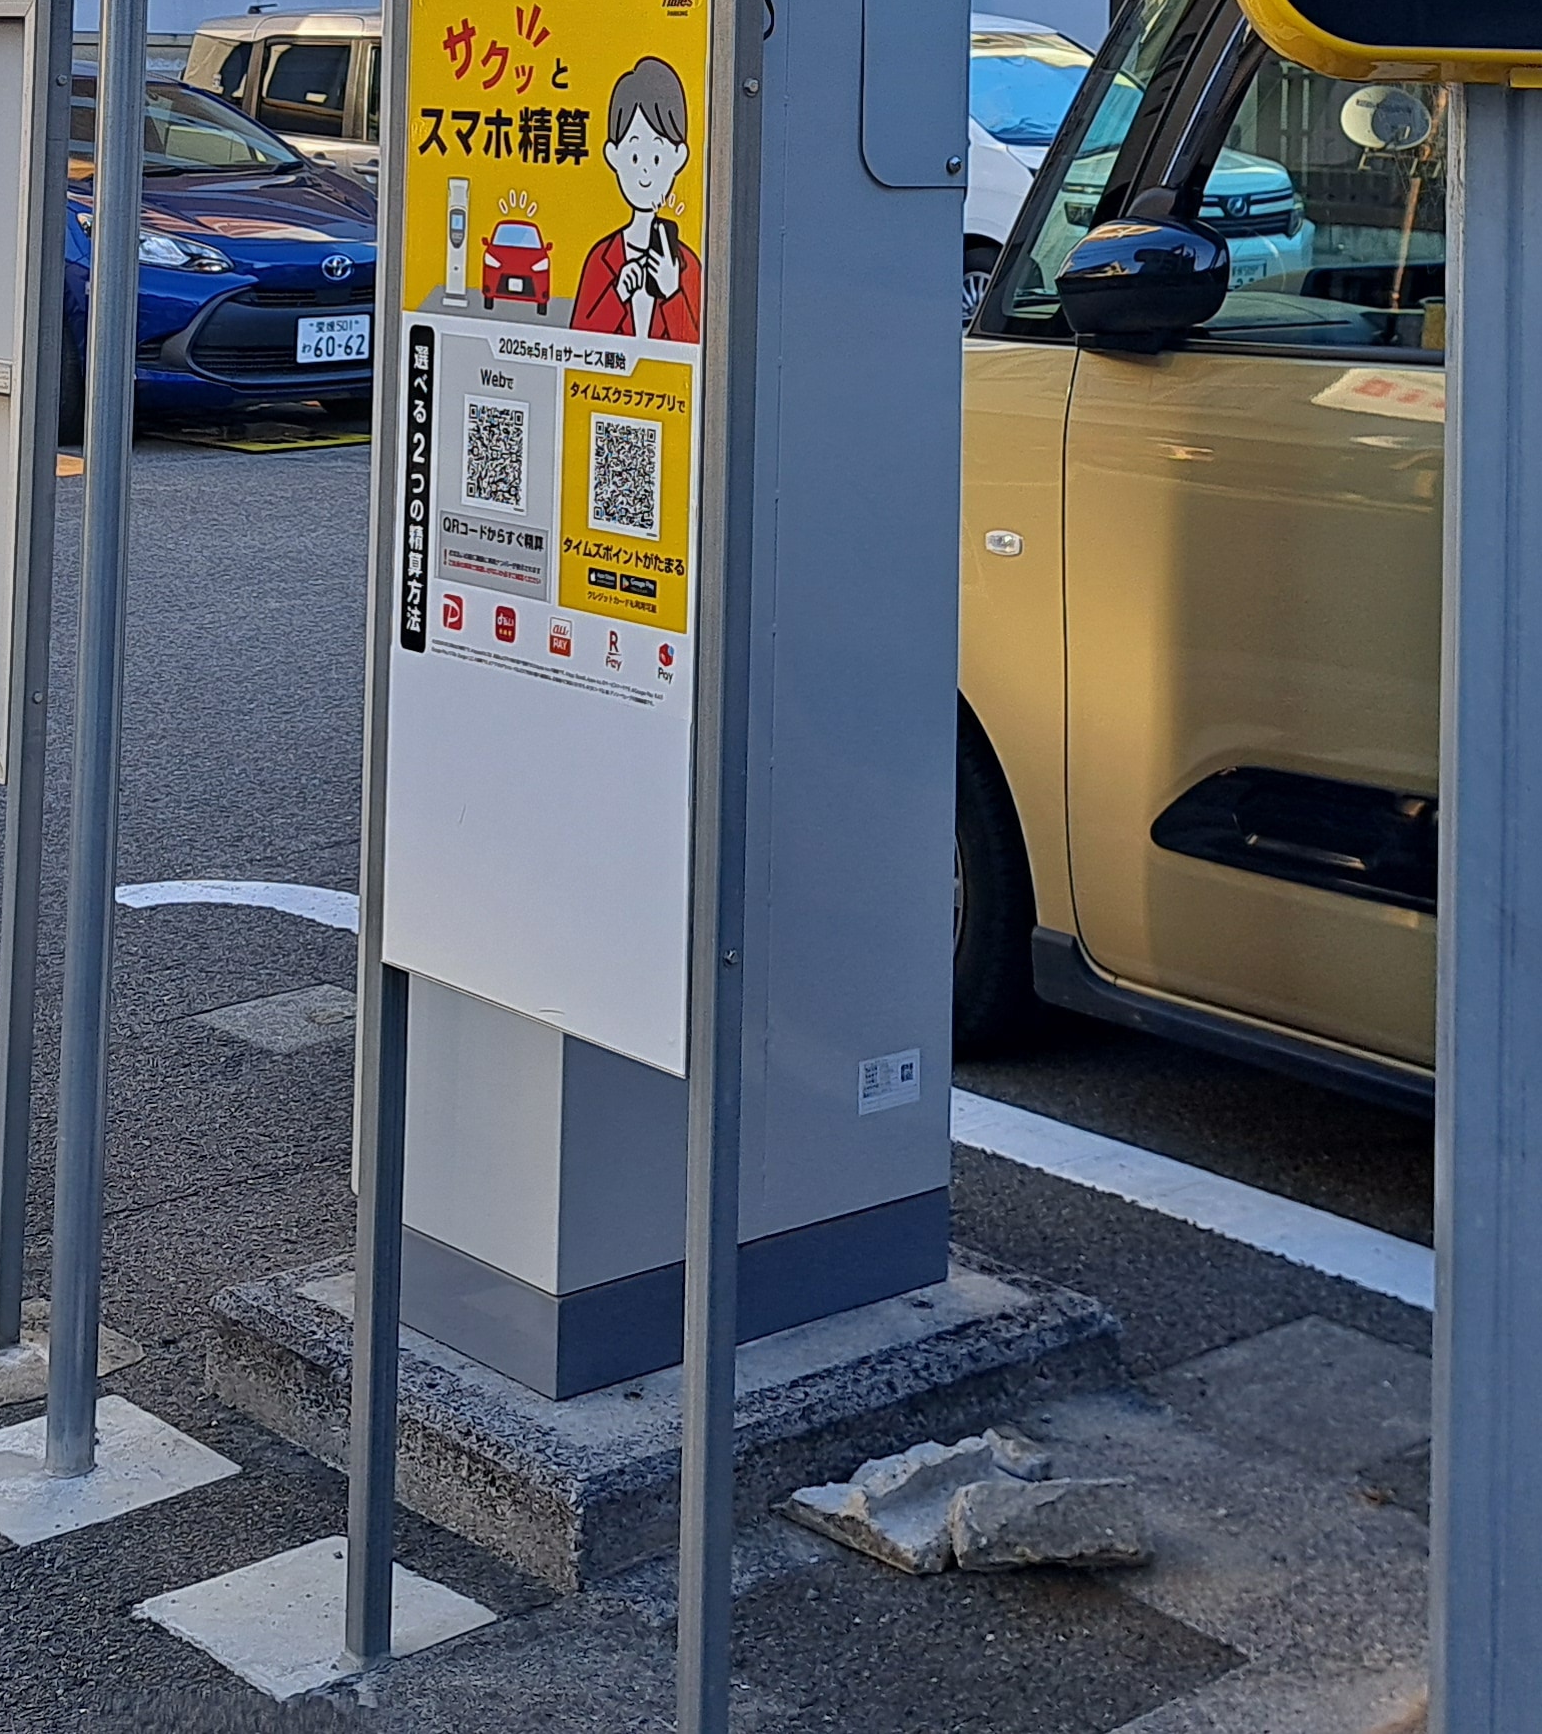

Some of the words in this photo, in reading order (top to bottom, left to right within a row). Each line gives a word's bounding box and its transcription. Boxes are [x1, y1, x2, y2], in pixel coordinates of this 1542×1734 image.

[442, 17, 570, 95] サクッと
[418, 107, 591, 166] スマホ精算
[498, 337, 627, 371] 2025年5月1日サービス開始
[480, 368, 514, 390] Webで
[569, 380, 686, 414] タイムズクラブアプリで
[405, 345, 430, 633] 選べる2つの精算方法
[442, 516, 545, 553] QRコードからすぐ精算
[562, 536, 686, 577] タイムズポイントがたまる
[605, 655, 622, 672] Pay
[657, 667, 674, 685] Pay
